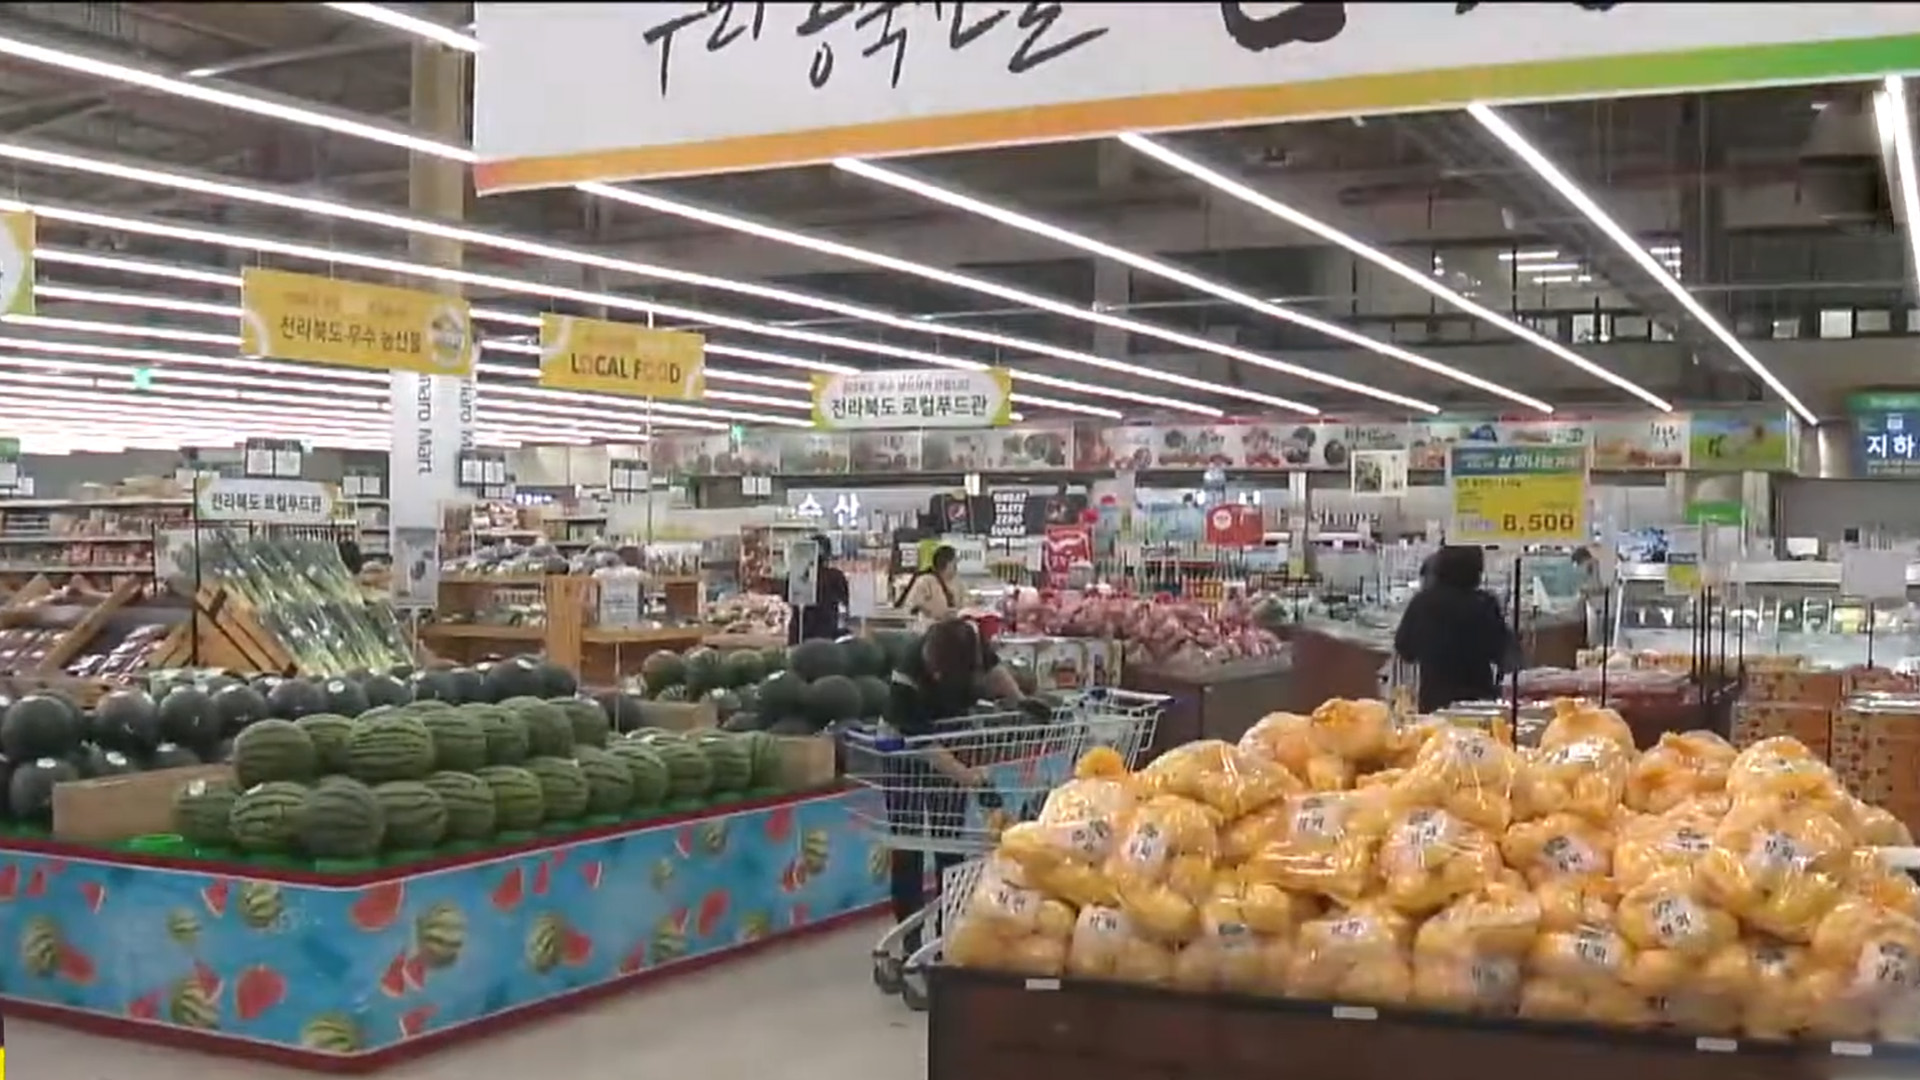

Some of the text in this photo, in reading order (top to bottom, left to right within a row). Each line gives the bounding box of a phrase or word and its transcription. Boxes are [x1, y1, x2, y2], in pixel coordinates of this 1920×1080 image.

[280, 315, 343, 344] 전라북도
[571, 352, 681, 384] LOCAL FOOD
[831, 394, 988, 419] 전라북도 로컬푸드관
[418, 427, 433, 474] Mart
[211, 492, 261, 512] 전라북도
